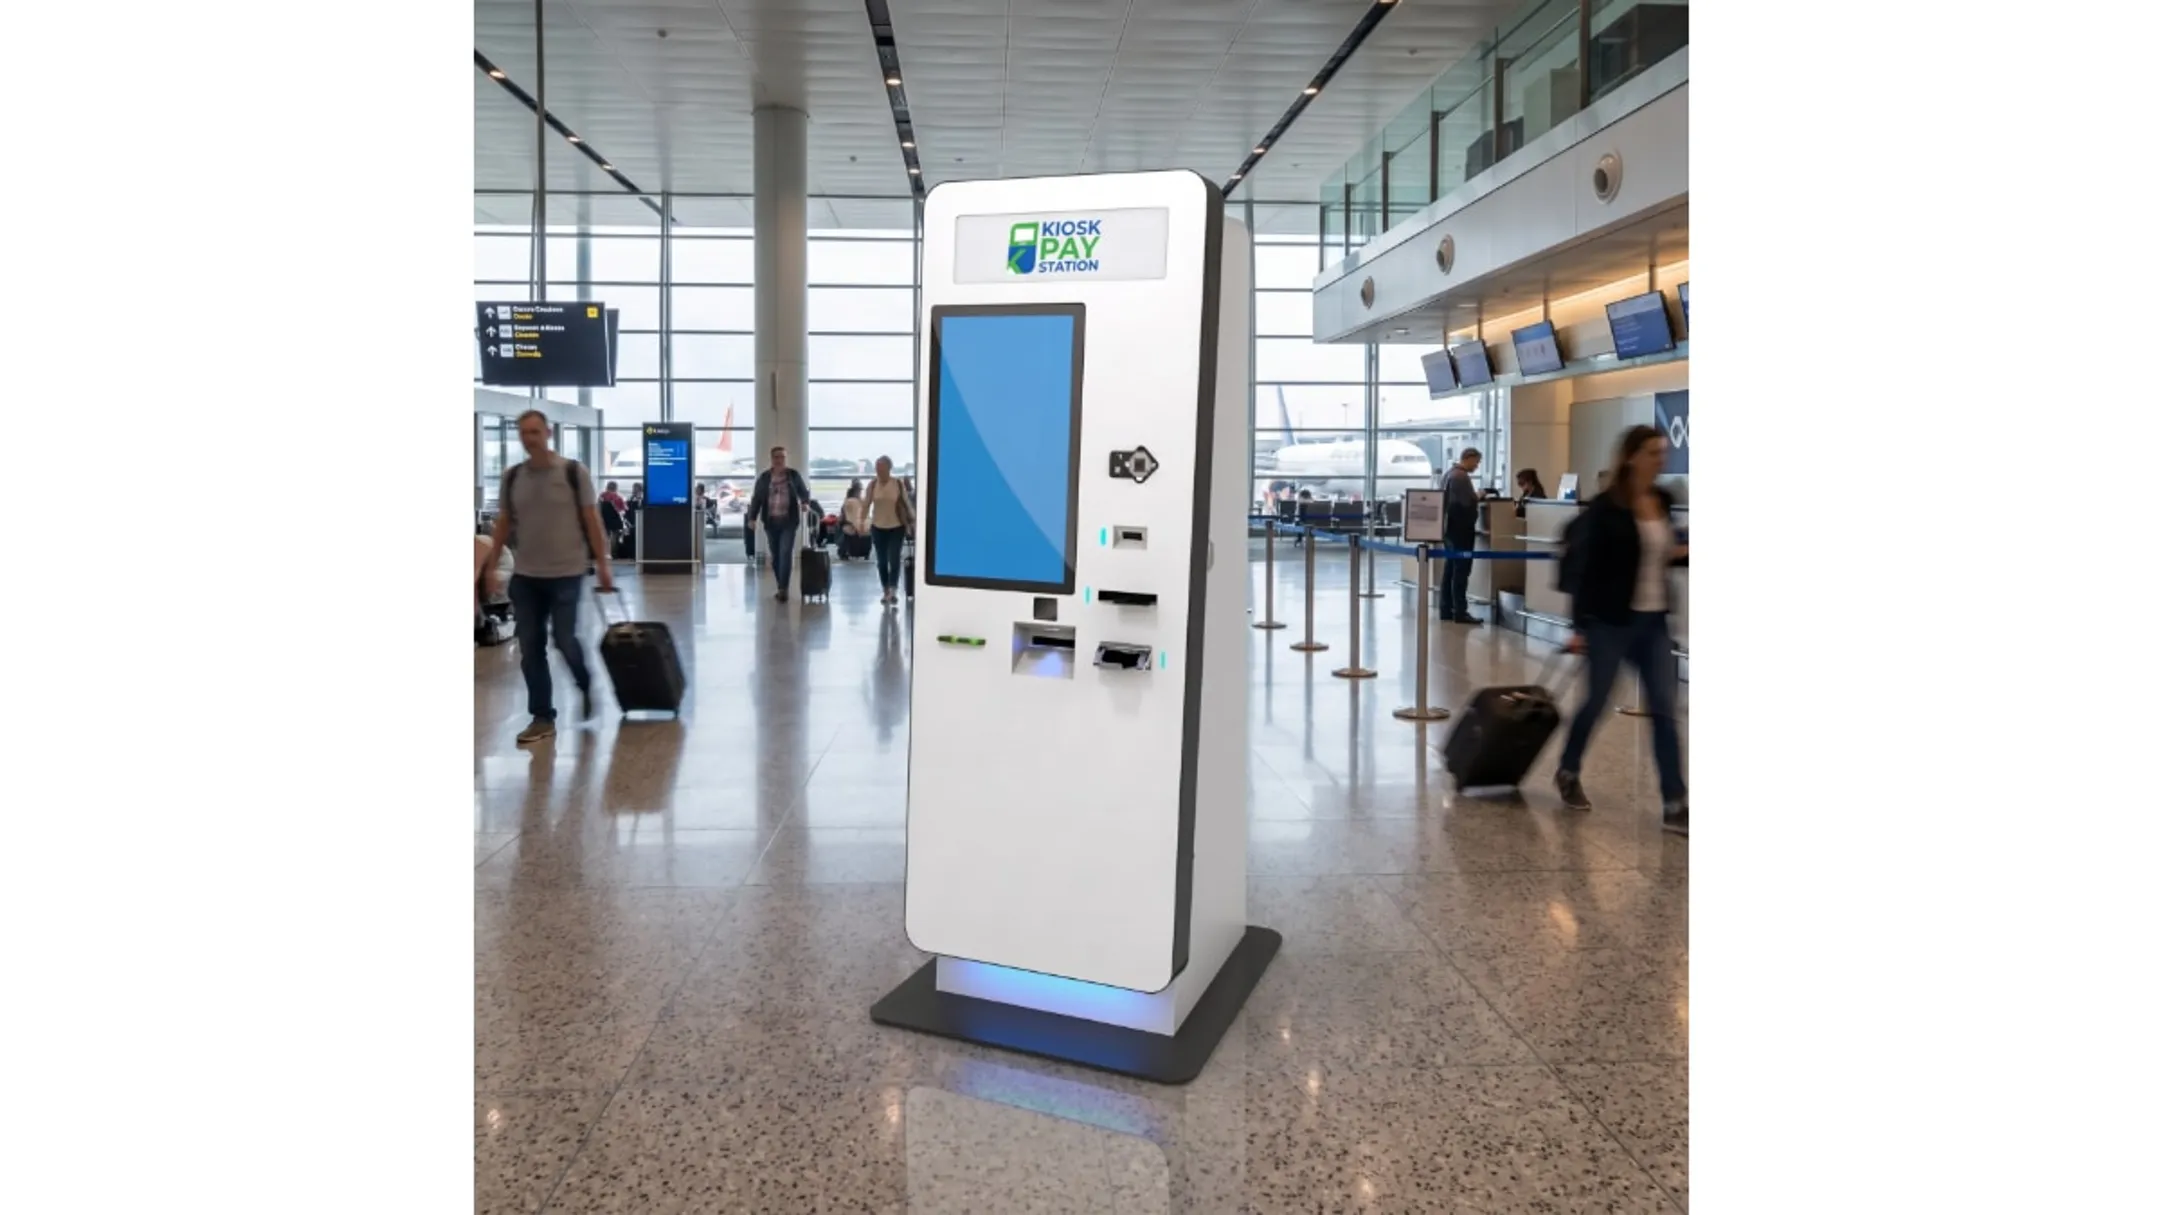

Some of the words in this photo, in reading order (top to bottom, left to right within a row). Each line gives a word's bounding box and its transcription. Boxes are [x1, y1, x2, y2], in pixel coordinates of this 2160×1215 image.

[1041, 220, 1101, 236] KIOSK
[1040, 236, 1100, 260] PAY
[1039, 260, 1099, 273] STATION
